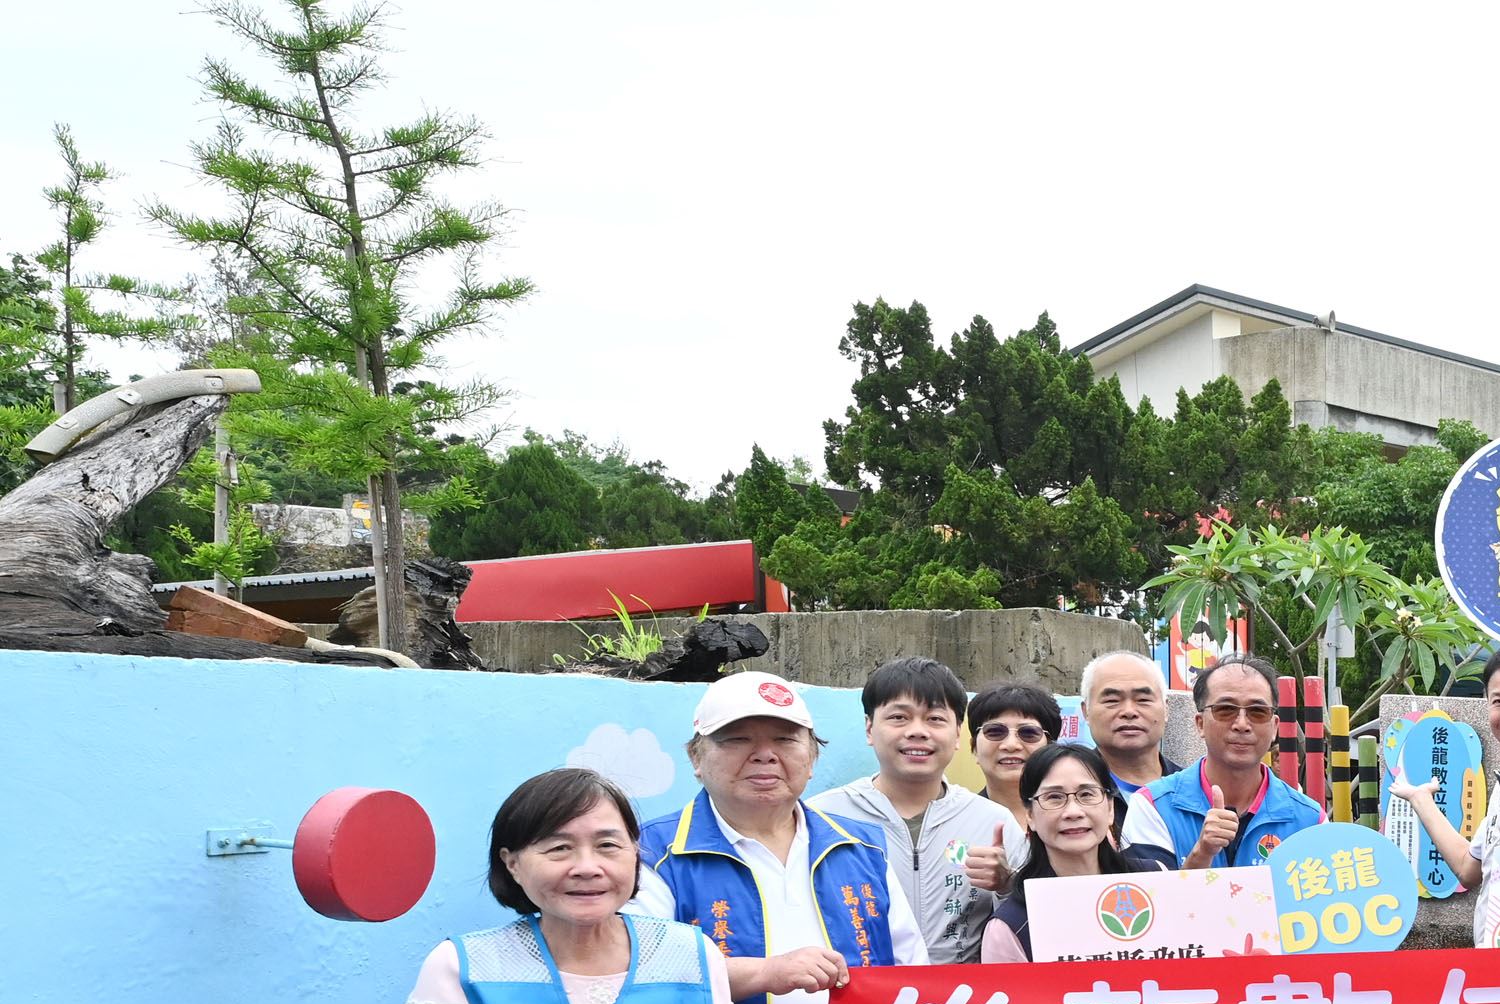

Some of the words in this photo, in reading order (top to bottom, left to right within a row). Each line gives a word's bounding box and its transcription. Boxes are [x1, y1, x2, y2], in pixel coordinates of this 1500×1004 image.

[1427, 726, 1449, 886] 後龍數位中心
[1284, 846, 1381, 901] 後龍
[1278, 893, 1403, 953] DOC
